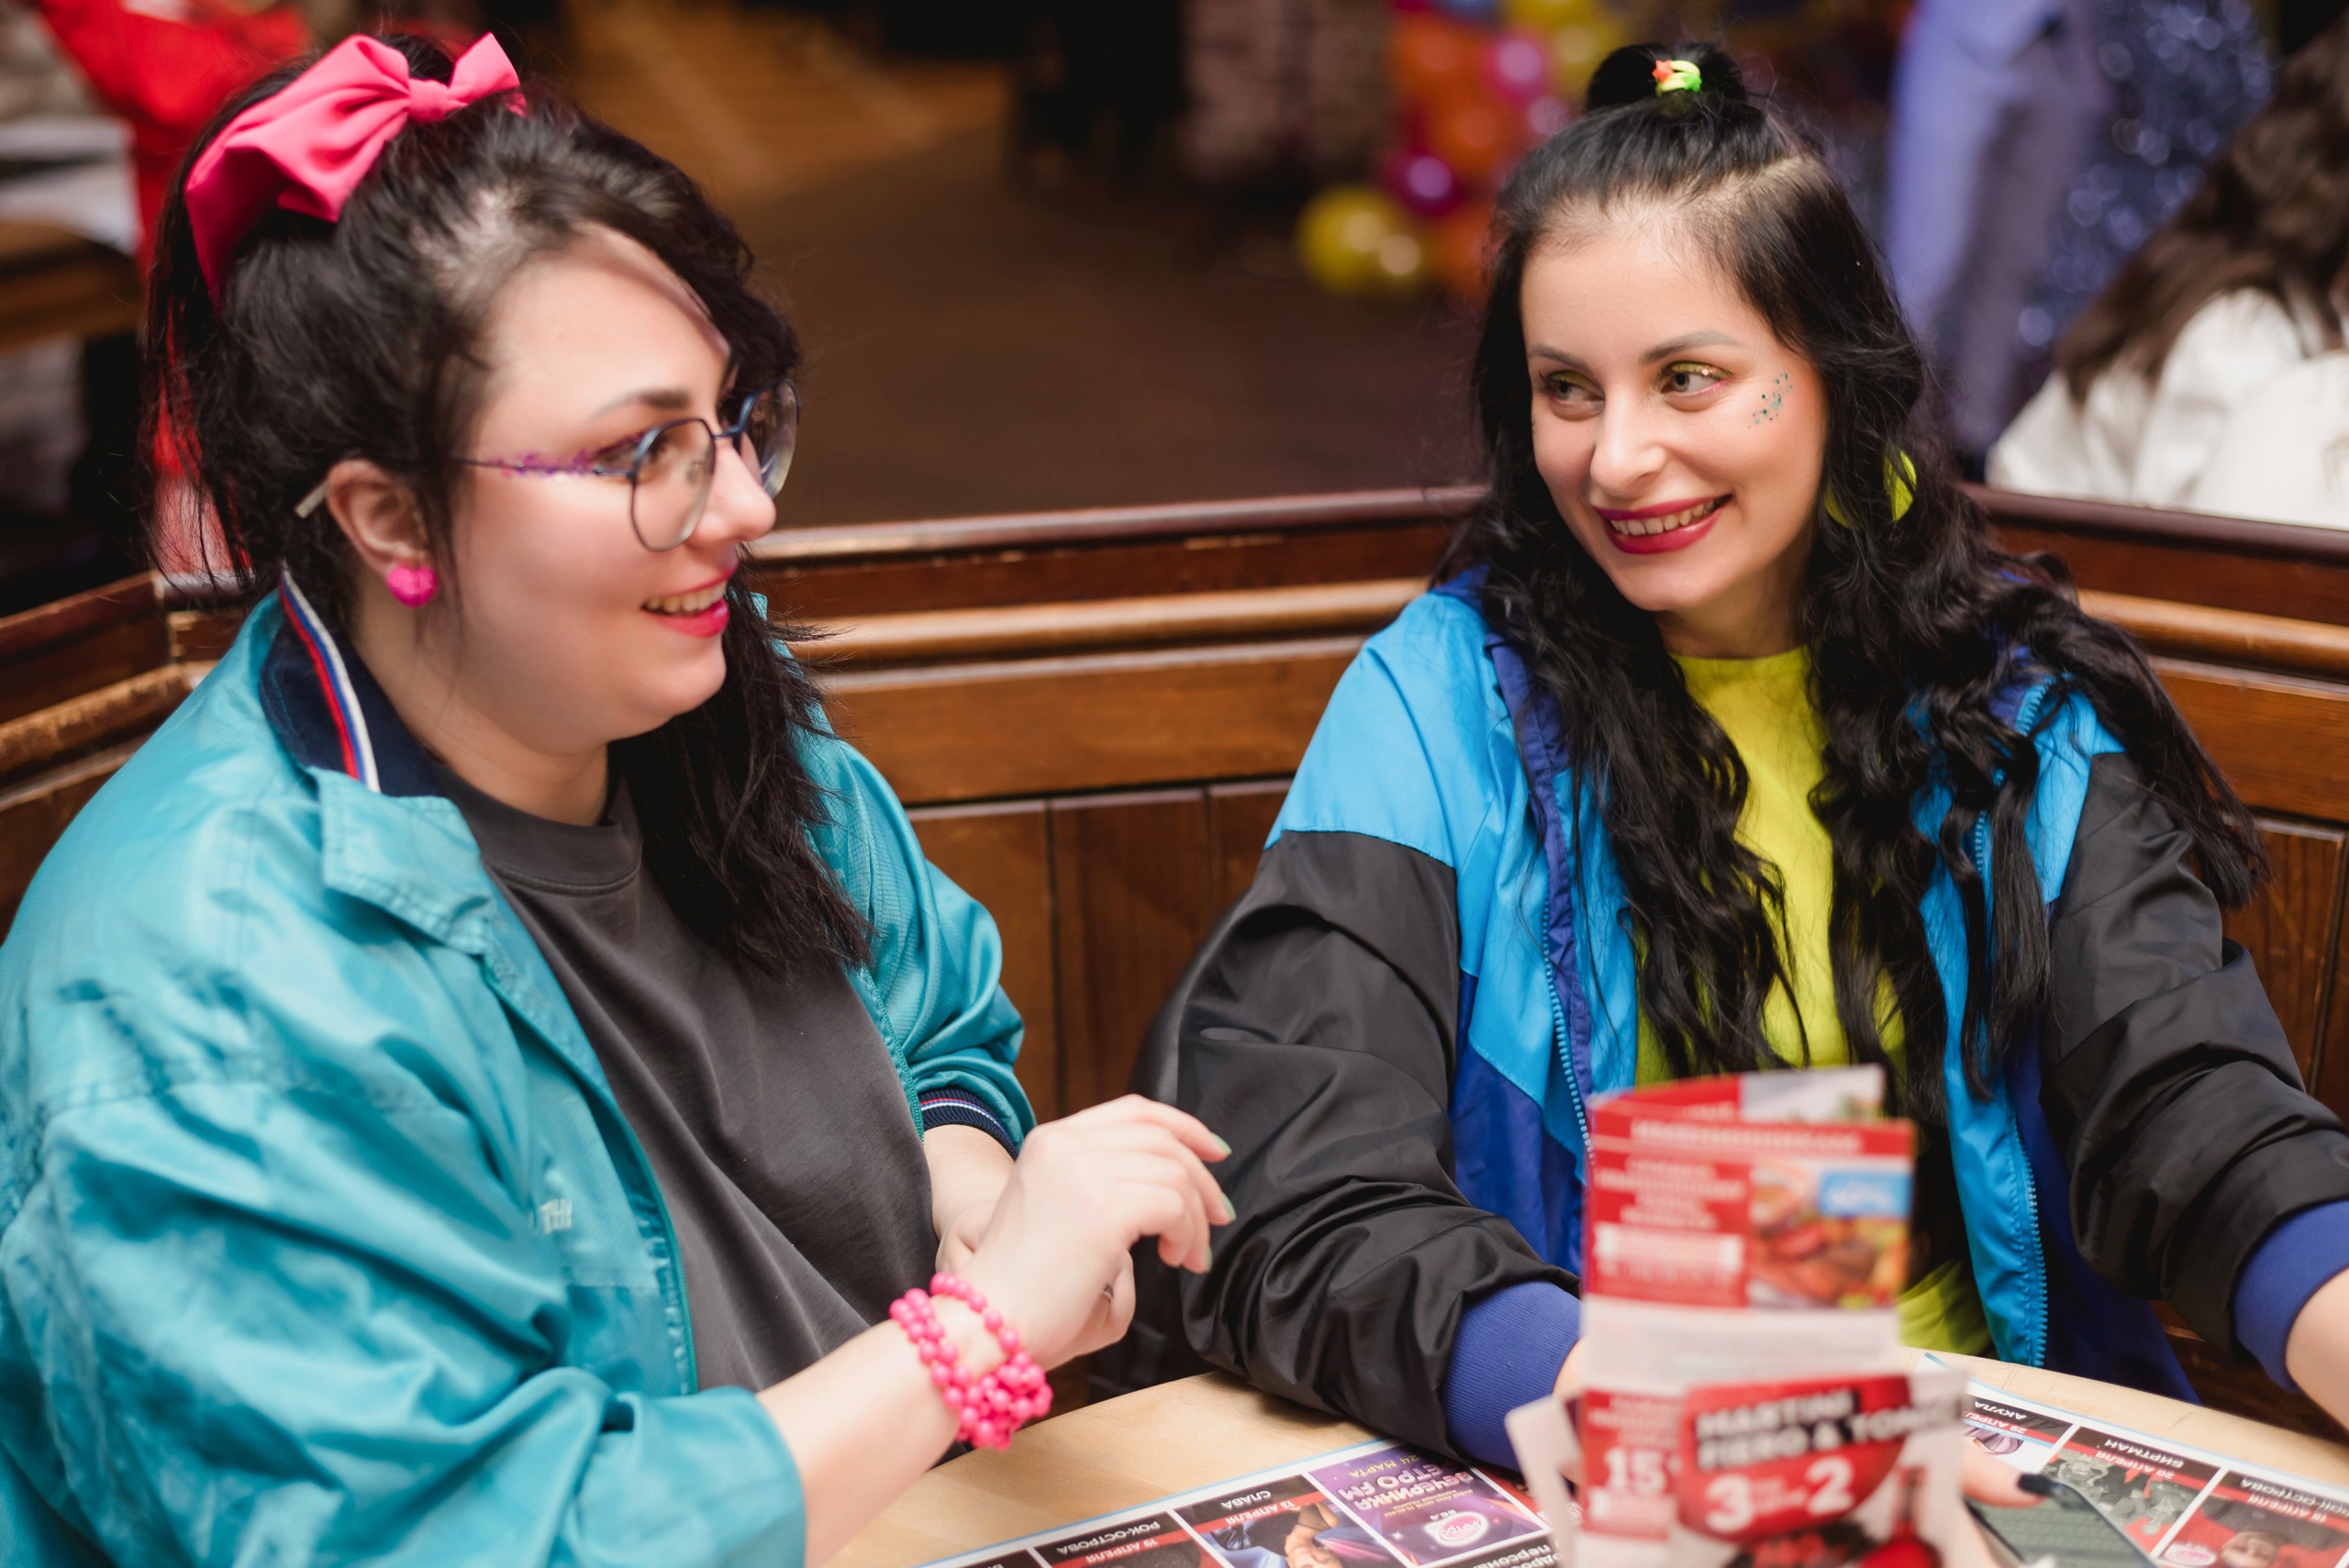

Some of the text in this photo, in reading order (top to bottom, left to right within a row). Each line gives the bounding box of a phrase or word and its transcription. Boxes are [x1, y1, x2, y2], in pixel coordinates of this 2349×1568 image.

[1962, 1410, 2027, 1434] 29 АПРЕЛ
[1974, 1401, 2027, 1420] АКУЛА
[2096, 1451, 2175, 1479] 20 АПРЕЛЯ
[2104, 1438, 2185, 1468] БИРТМАН
[1349, 1454, 1419, 1479] 24 МАРТА
[1337, 1462, 1446, 1501] ЕТРО FM
[1353, 1471, 1475, 1510] ВЕЧЕРИНКА
[1705, 1473, 1754, 1533] 3
[1805, 1455, 1854, 1516] 2
[1220, 1490, 1271, 1510] СЛАВА
[1225, 1500, 1295, 1524] 13 АПРЕЛЯ
[2246, 1494, 2310, 1519] АПРЕЛЯ
[1056, 1520, 1161, 1554] РОК-ОСТРОВА
[1085, 1538, 1158, 1563] 19 АПРЕЛЯ
[1473, 1544, 1551, 1568] персона
